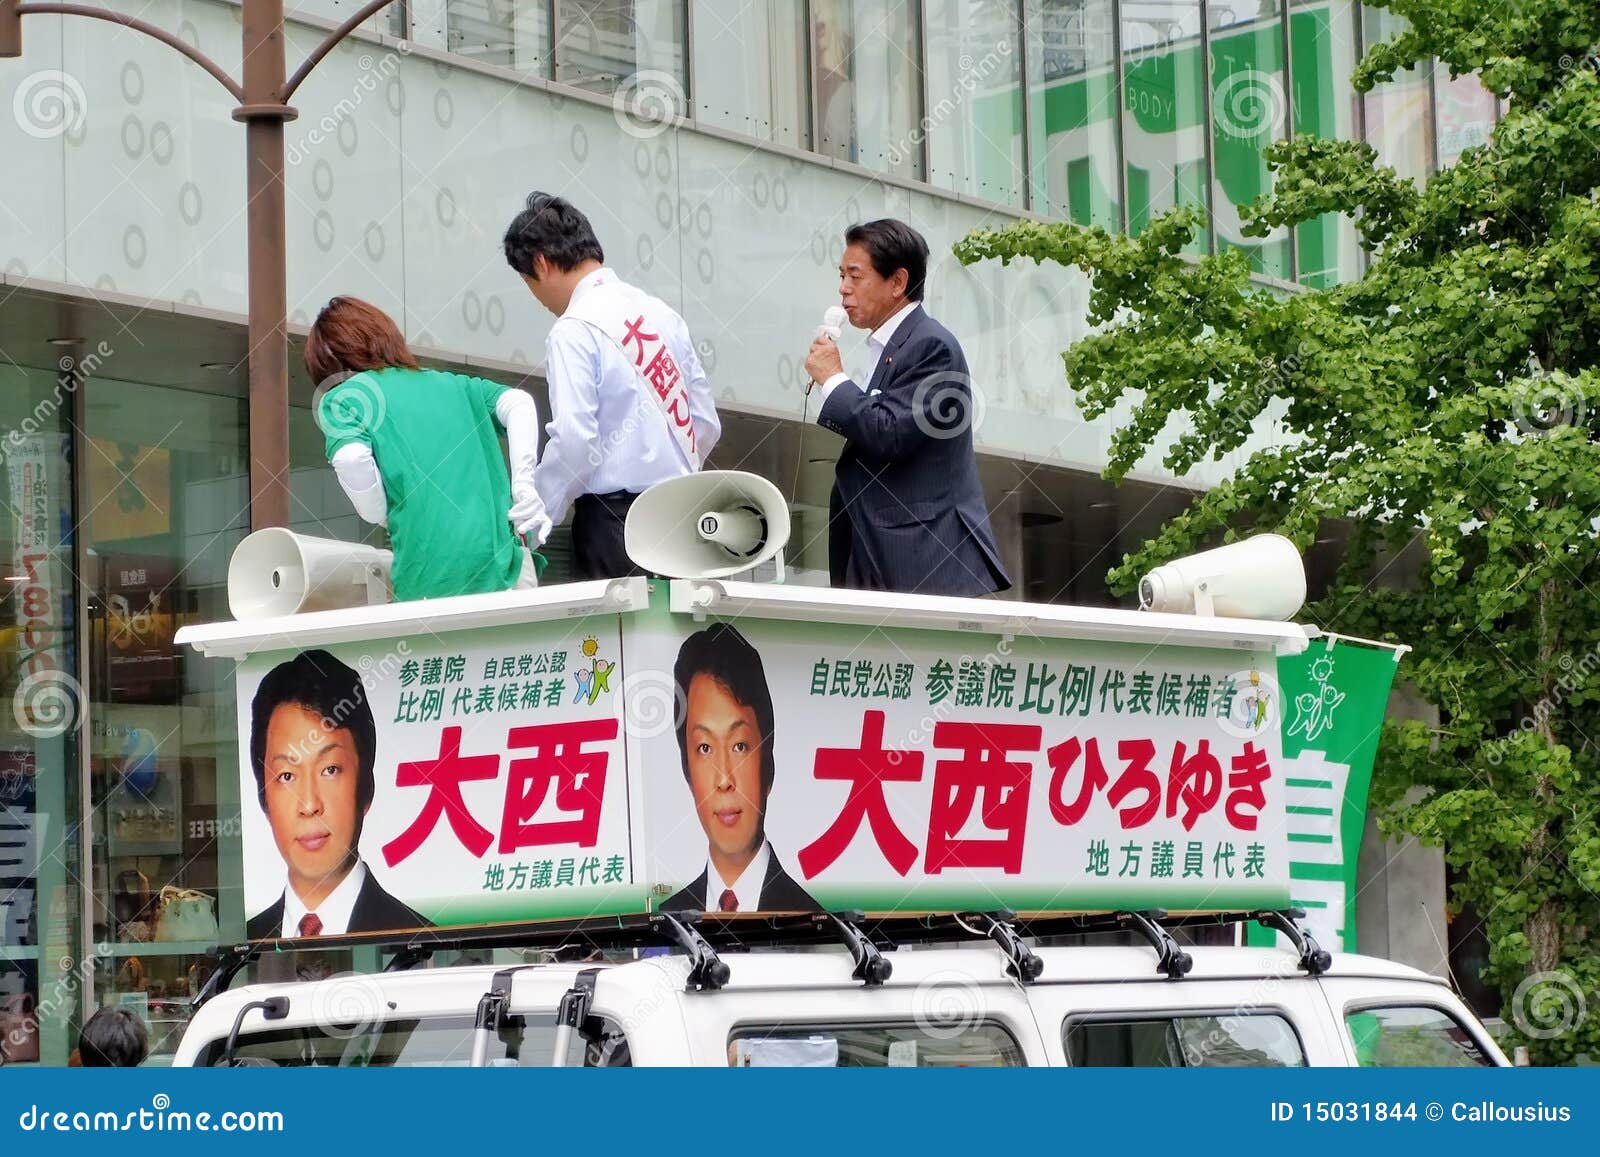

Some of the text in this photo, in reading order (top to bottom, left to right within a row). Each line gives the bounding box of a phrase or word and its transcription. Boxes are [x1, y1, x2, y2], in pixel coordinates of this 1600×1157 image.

[1129, 87, 1173, 120] BODY
[398, 651, 567, 687] 参議院 自民党公認
[810, 656, 914, 700] 自民党公認
[381, 718, 619, 868] 大西
[482, 854, 625, 891] 地方議員代表
[1085, 838, 1266, 879] 地方議員代表
